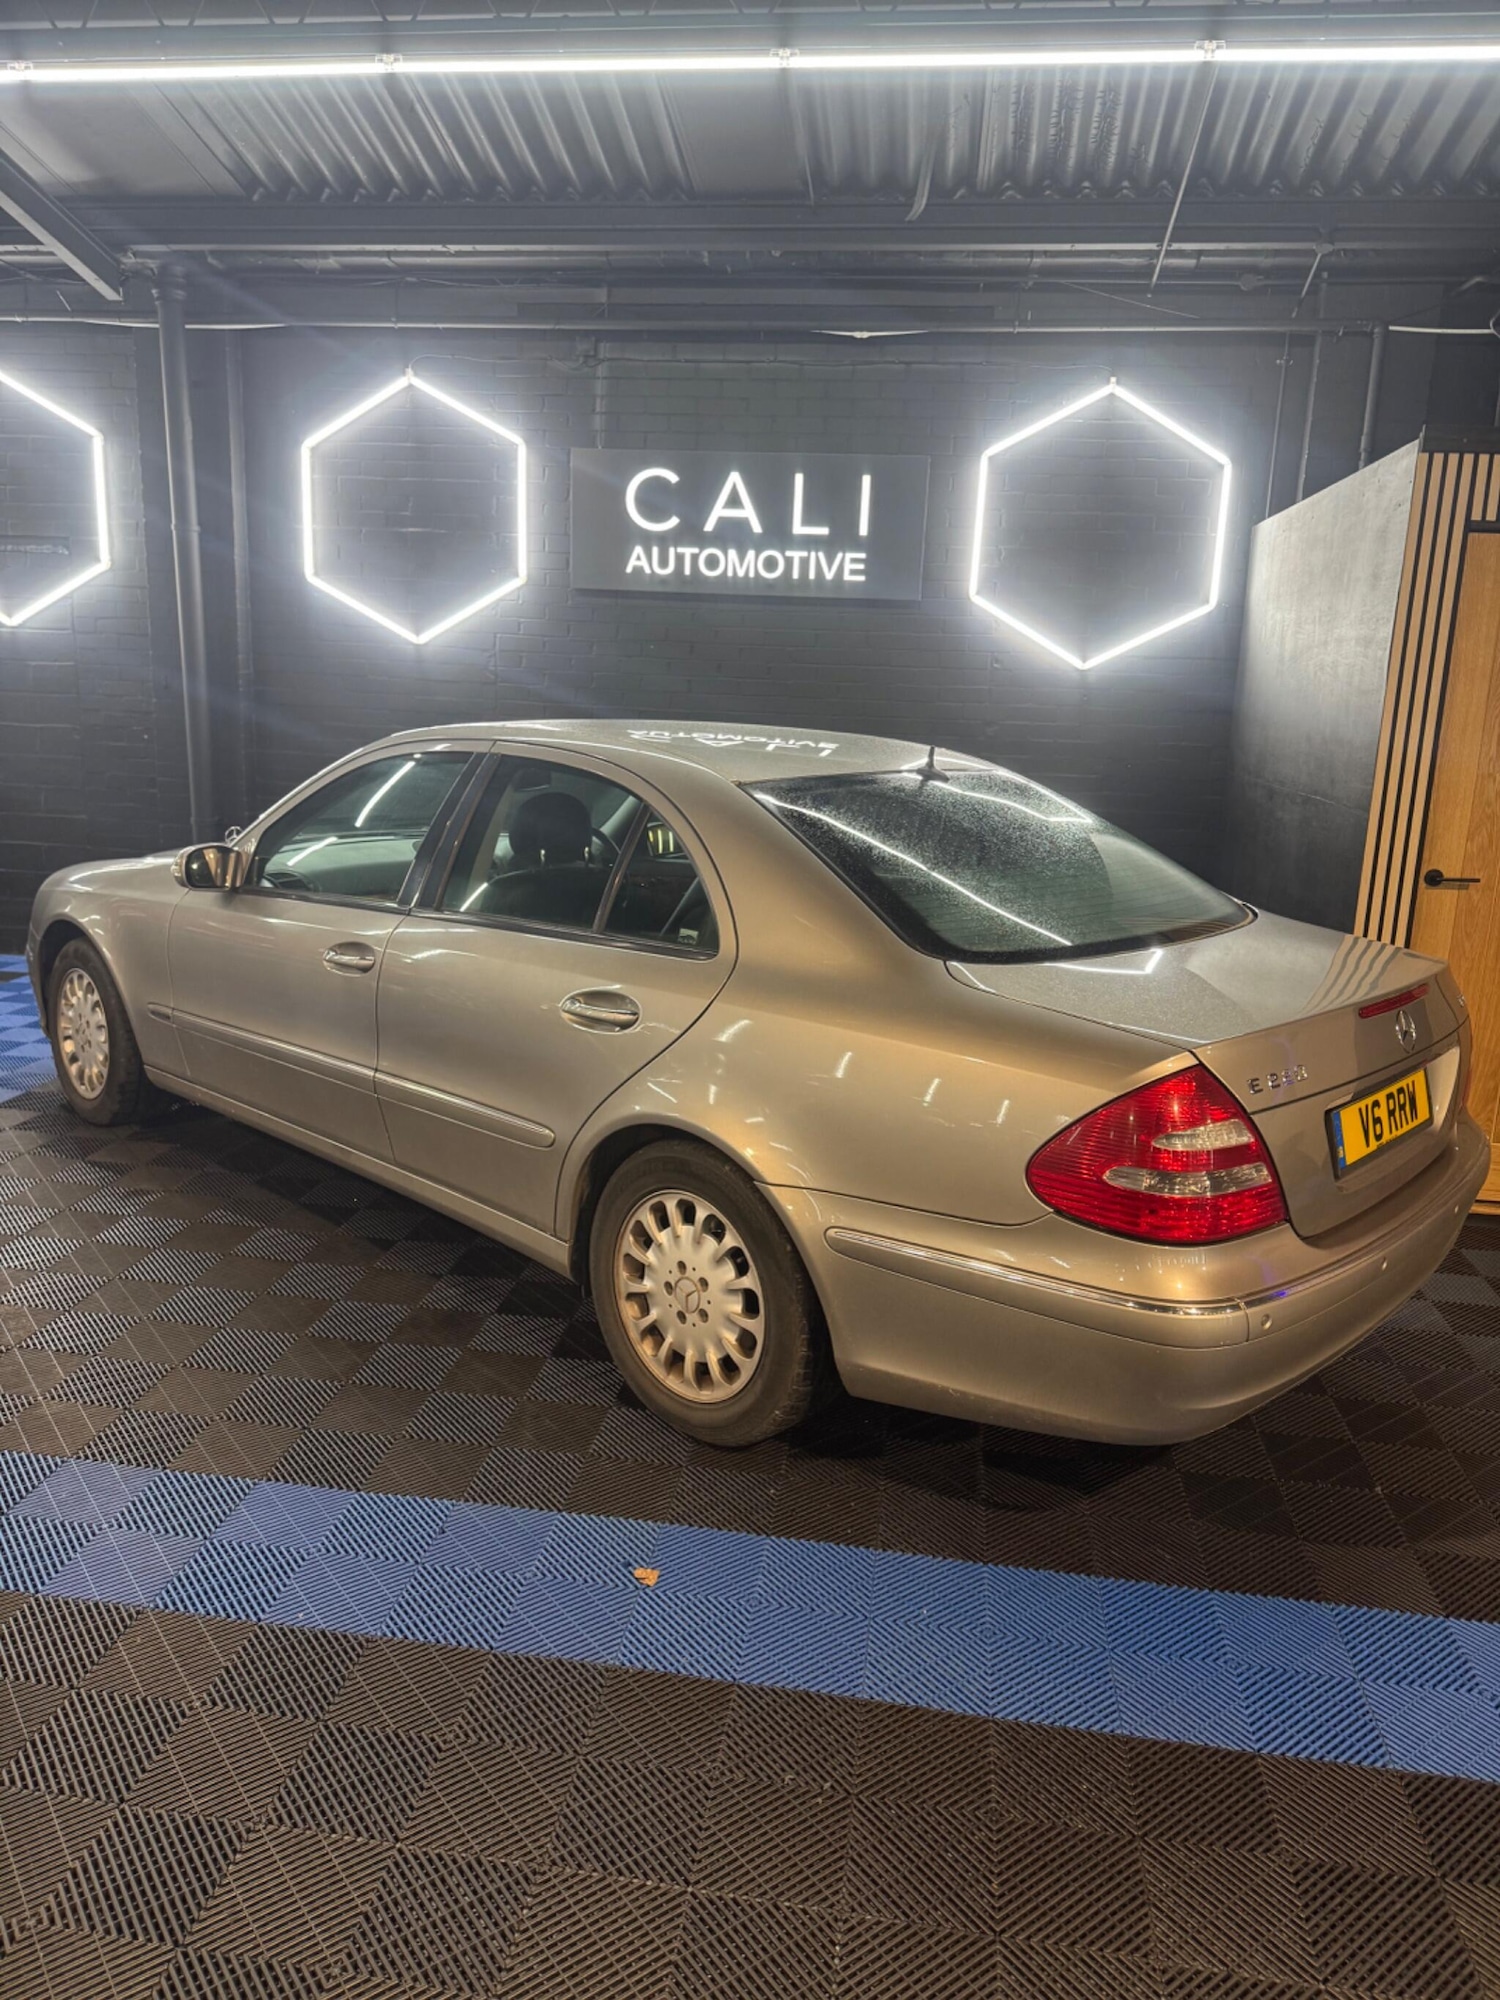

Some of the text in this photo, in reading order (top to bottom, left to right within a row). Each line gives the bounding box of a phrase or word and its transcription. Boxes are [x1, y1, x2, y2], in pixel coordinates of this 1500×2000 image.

[625, 467, 871, 536] CALI
[625, 546, 867, 581] AUTOMOTIVE
[1247, 1078, 1263, 1094] E
[1358, 1080, 1418, 1149] V6 RRW
